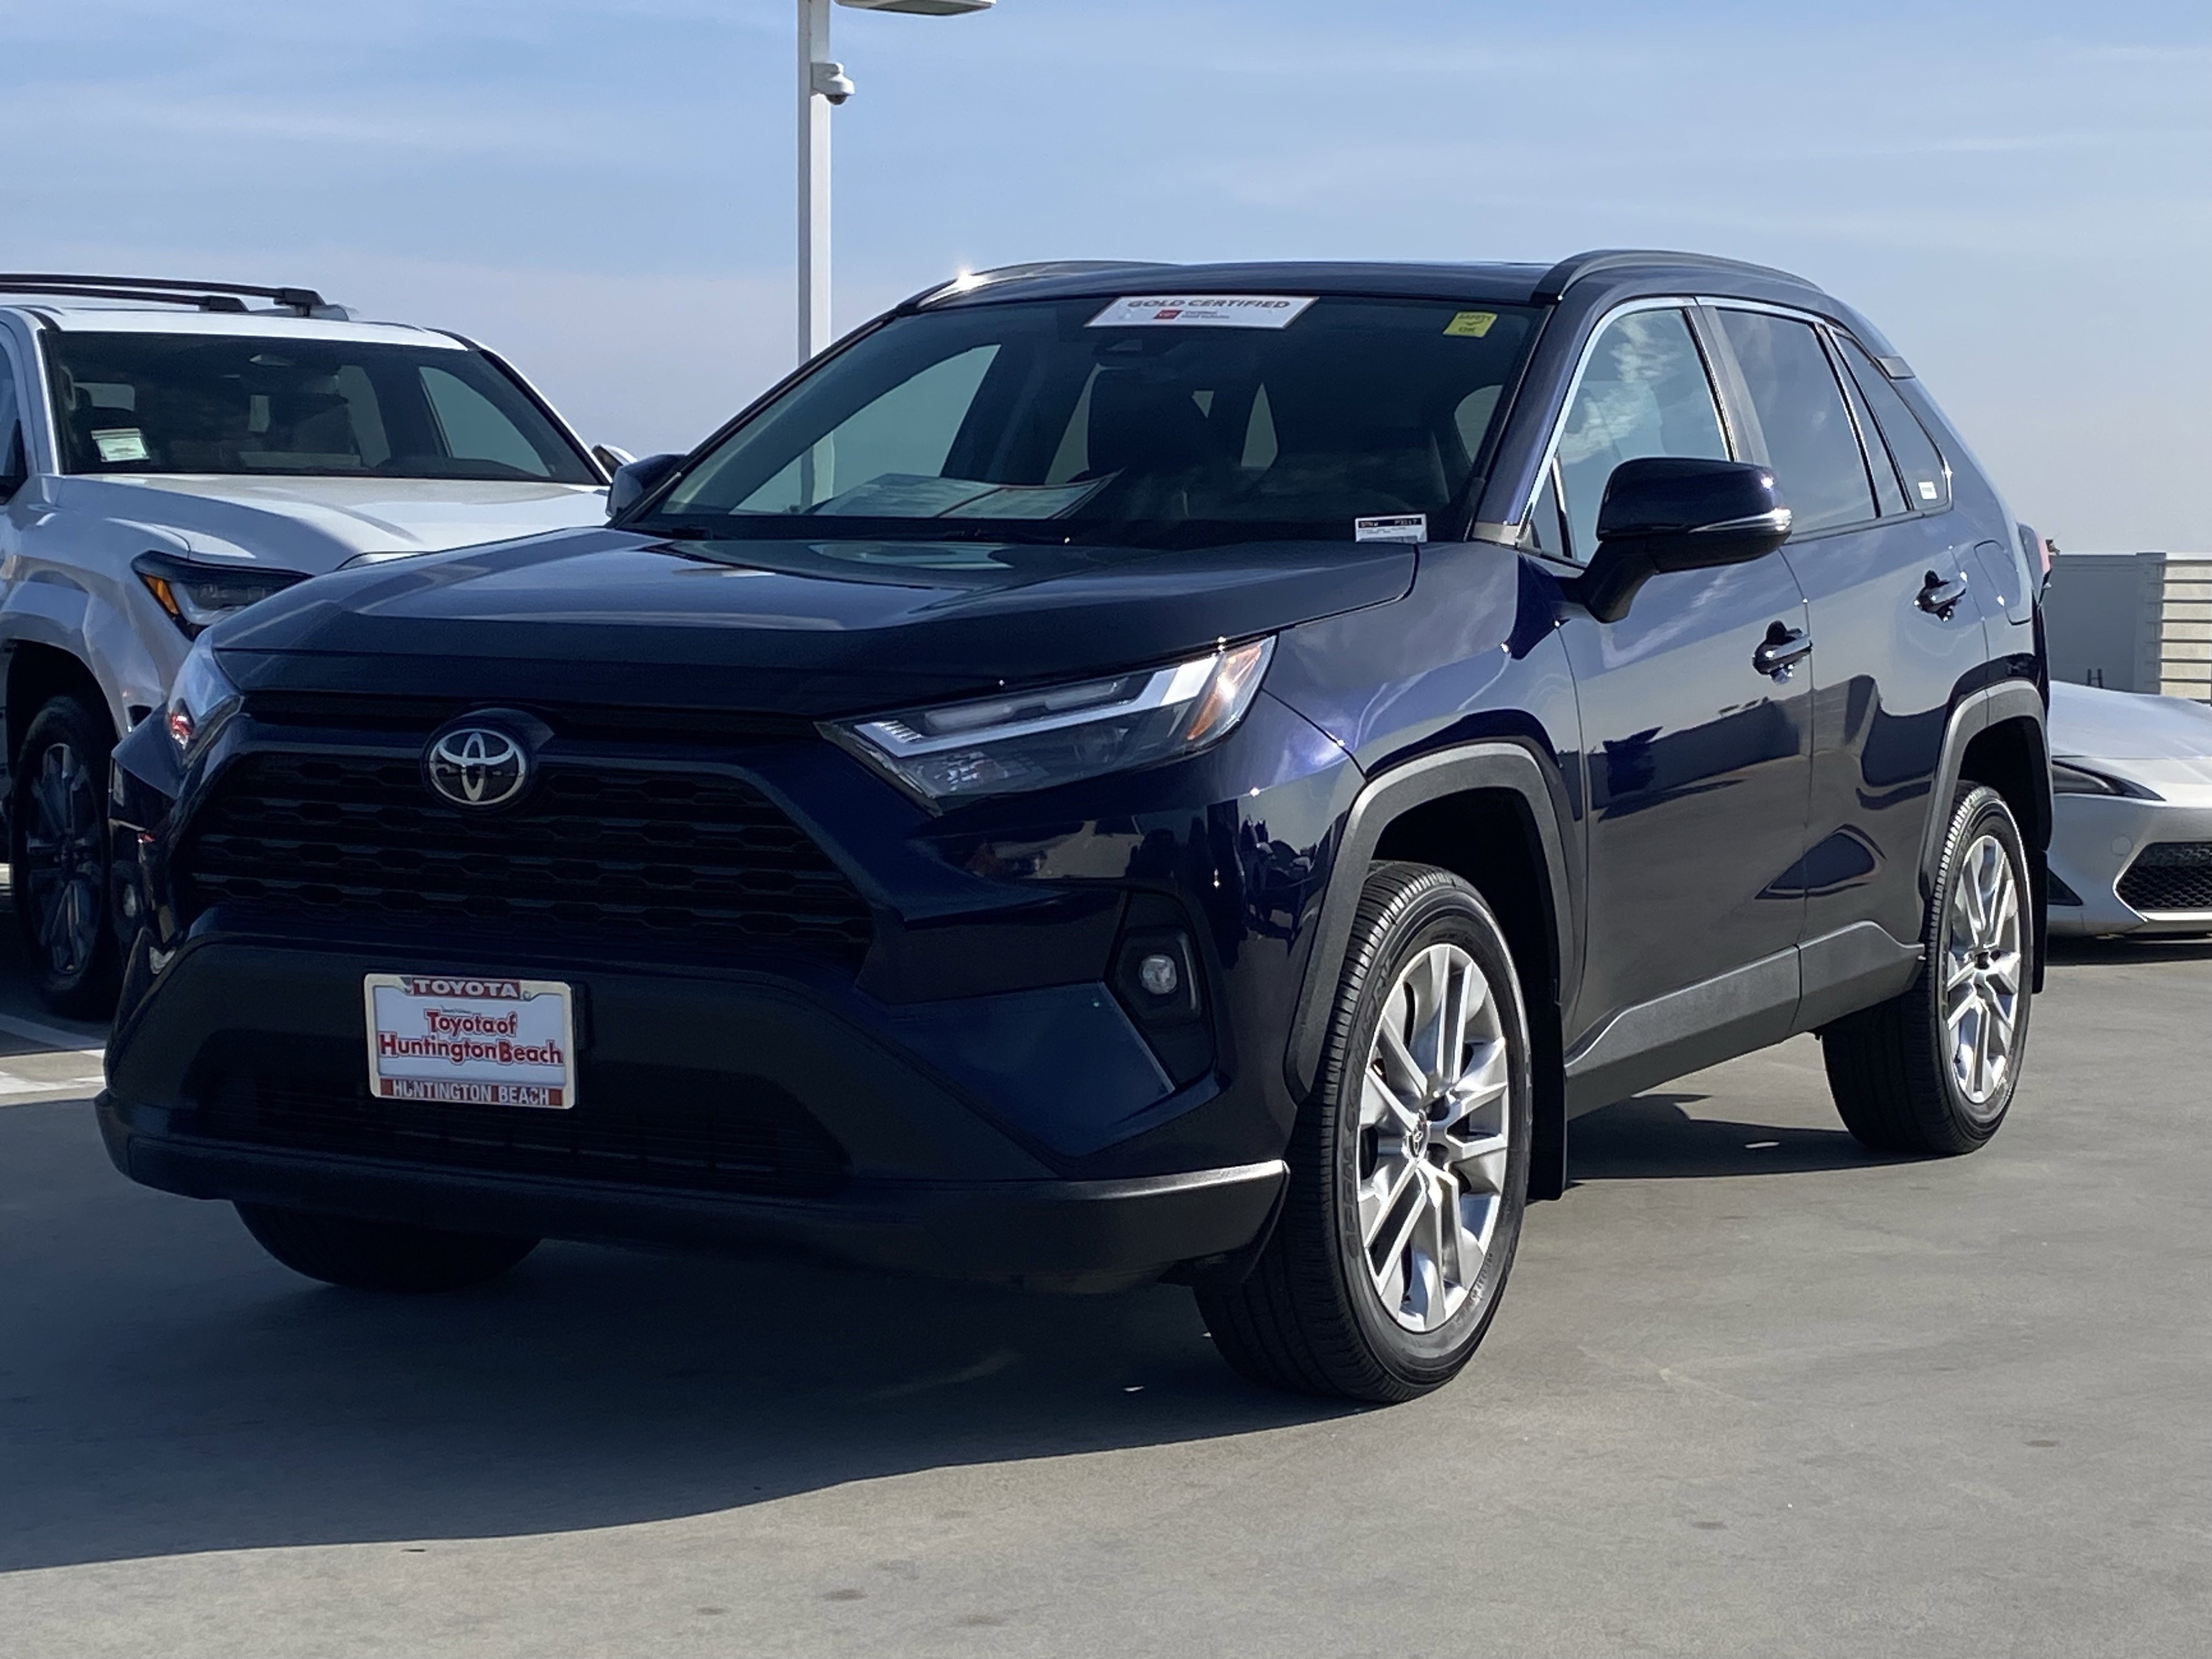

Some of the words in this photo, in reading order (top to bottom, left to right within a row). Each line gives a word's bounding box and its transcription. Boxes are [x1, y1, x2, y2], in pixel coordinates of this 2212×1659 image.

[1127, 299, 1185, 308] GOLD
[1188, 299, 1290, 308] CERTIFIED
[414, 979, 518, 997] TOYOTA
[426, 1011, 494, 1036] Toyota
[495, 1012, 516, 1034] of
[379, 1034, 496, 1062] Huntington
[498, 1041, 563, 1064] Beach
[392, 1080, 492, 1099] HUNTINGTON
[500, 1086, 549, 1105] BEACH
